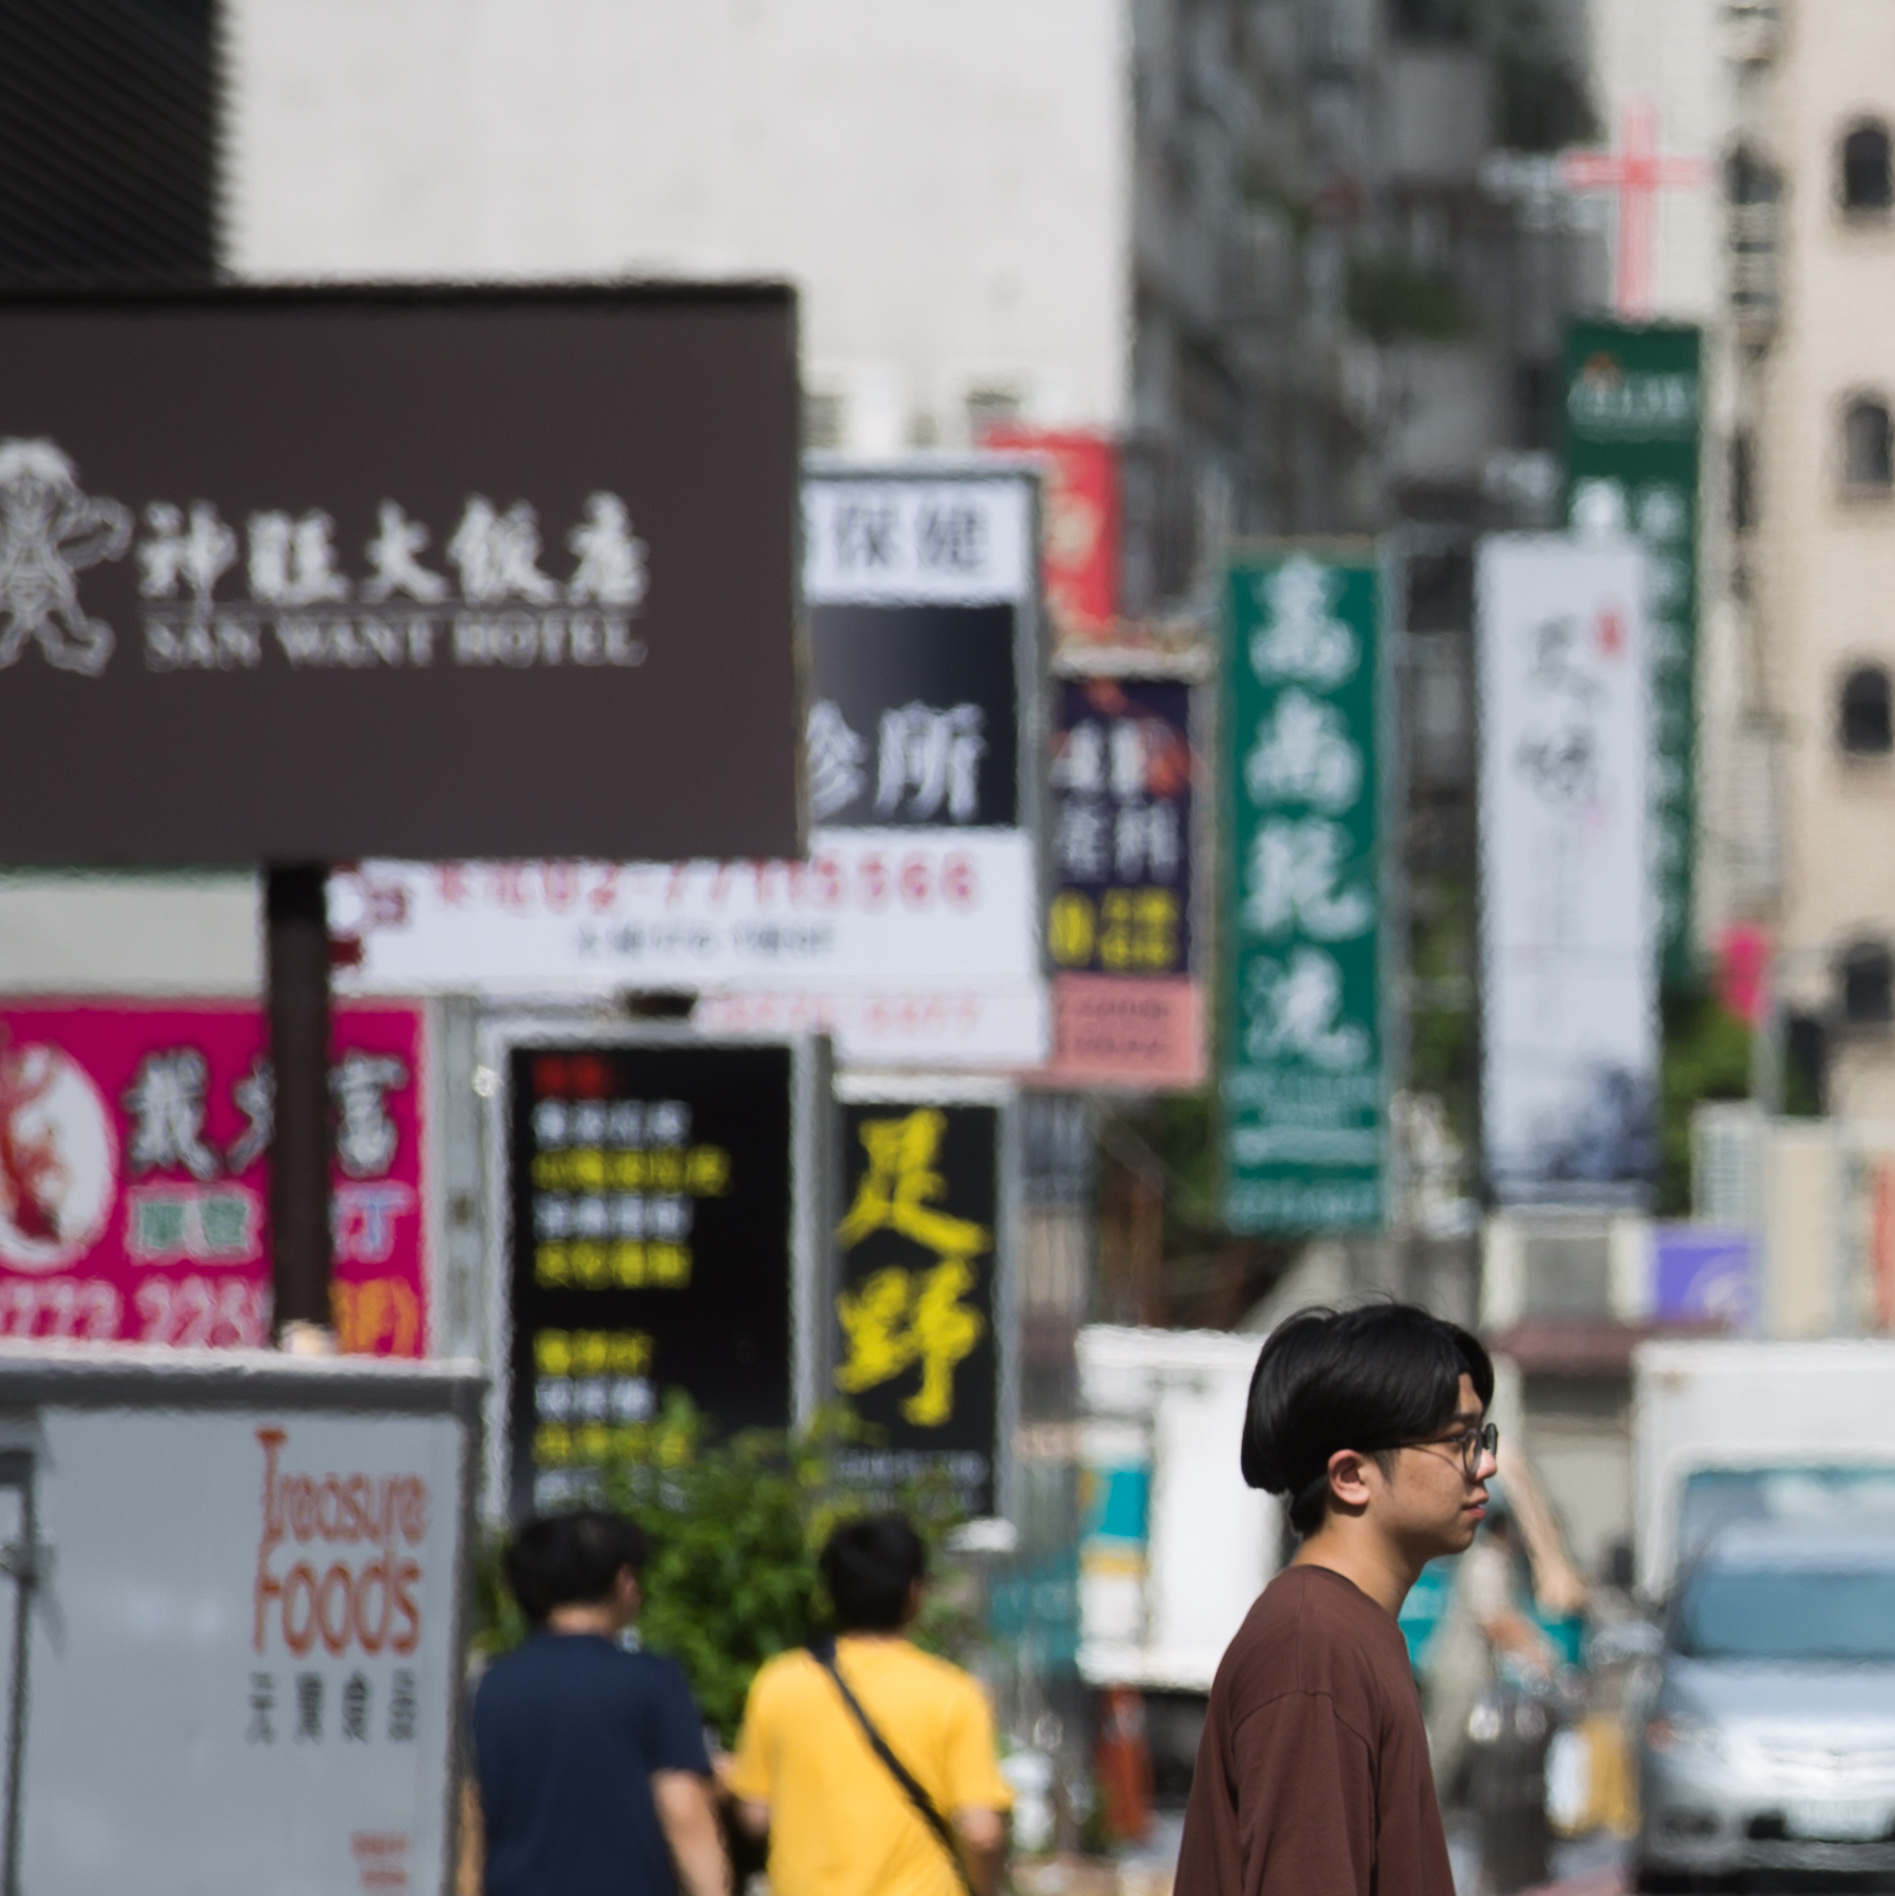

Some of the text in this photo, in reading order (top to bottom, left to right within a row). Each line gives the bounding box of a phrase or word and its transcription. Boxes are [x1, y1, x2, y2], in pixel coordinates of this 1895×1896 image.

[144, 612, 647, 670] SAN WANT HOTEL
[254, 1425, 429, 1546] Treasure
[253, 1545, 422, 1657] Foods
